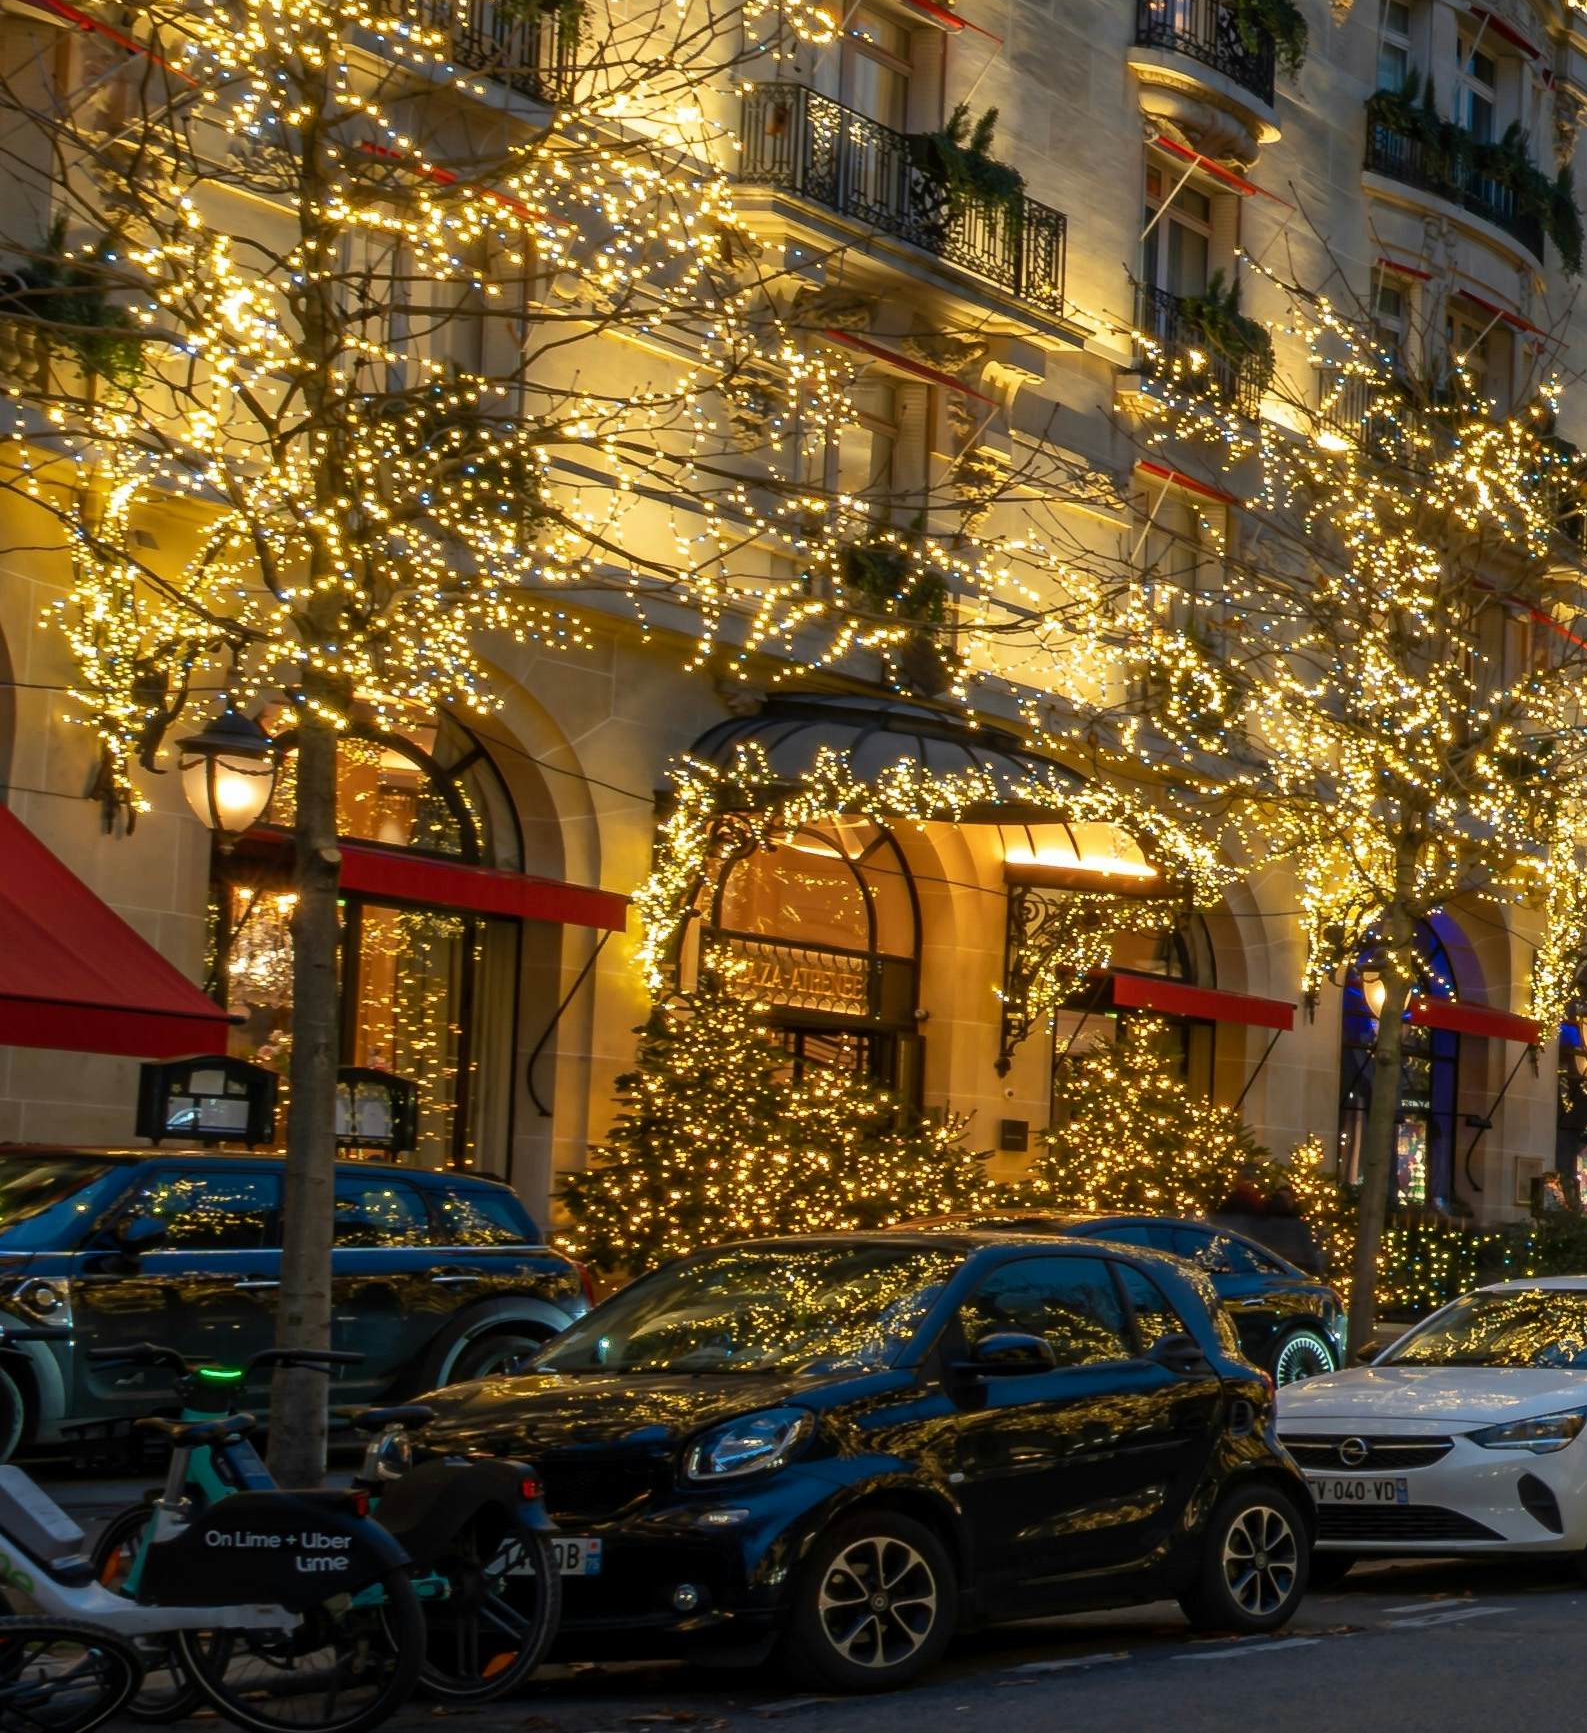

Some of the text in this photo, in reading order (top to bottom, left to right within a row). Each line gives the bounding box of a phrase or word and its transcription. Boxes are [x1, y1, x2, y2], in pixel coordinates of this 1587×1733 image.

[205, 1530, 232, 1546] On
[236, 1531, 281, 1548] Lime
[301, 1532, 352, 1549] Uber
[296, 1555, 349, 1572] Lime
